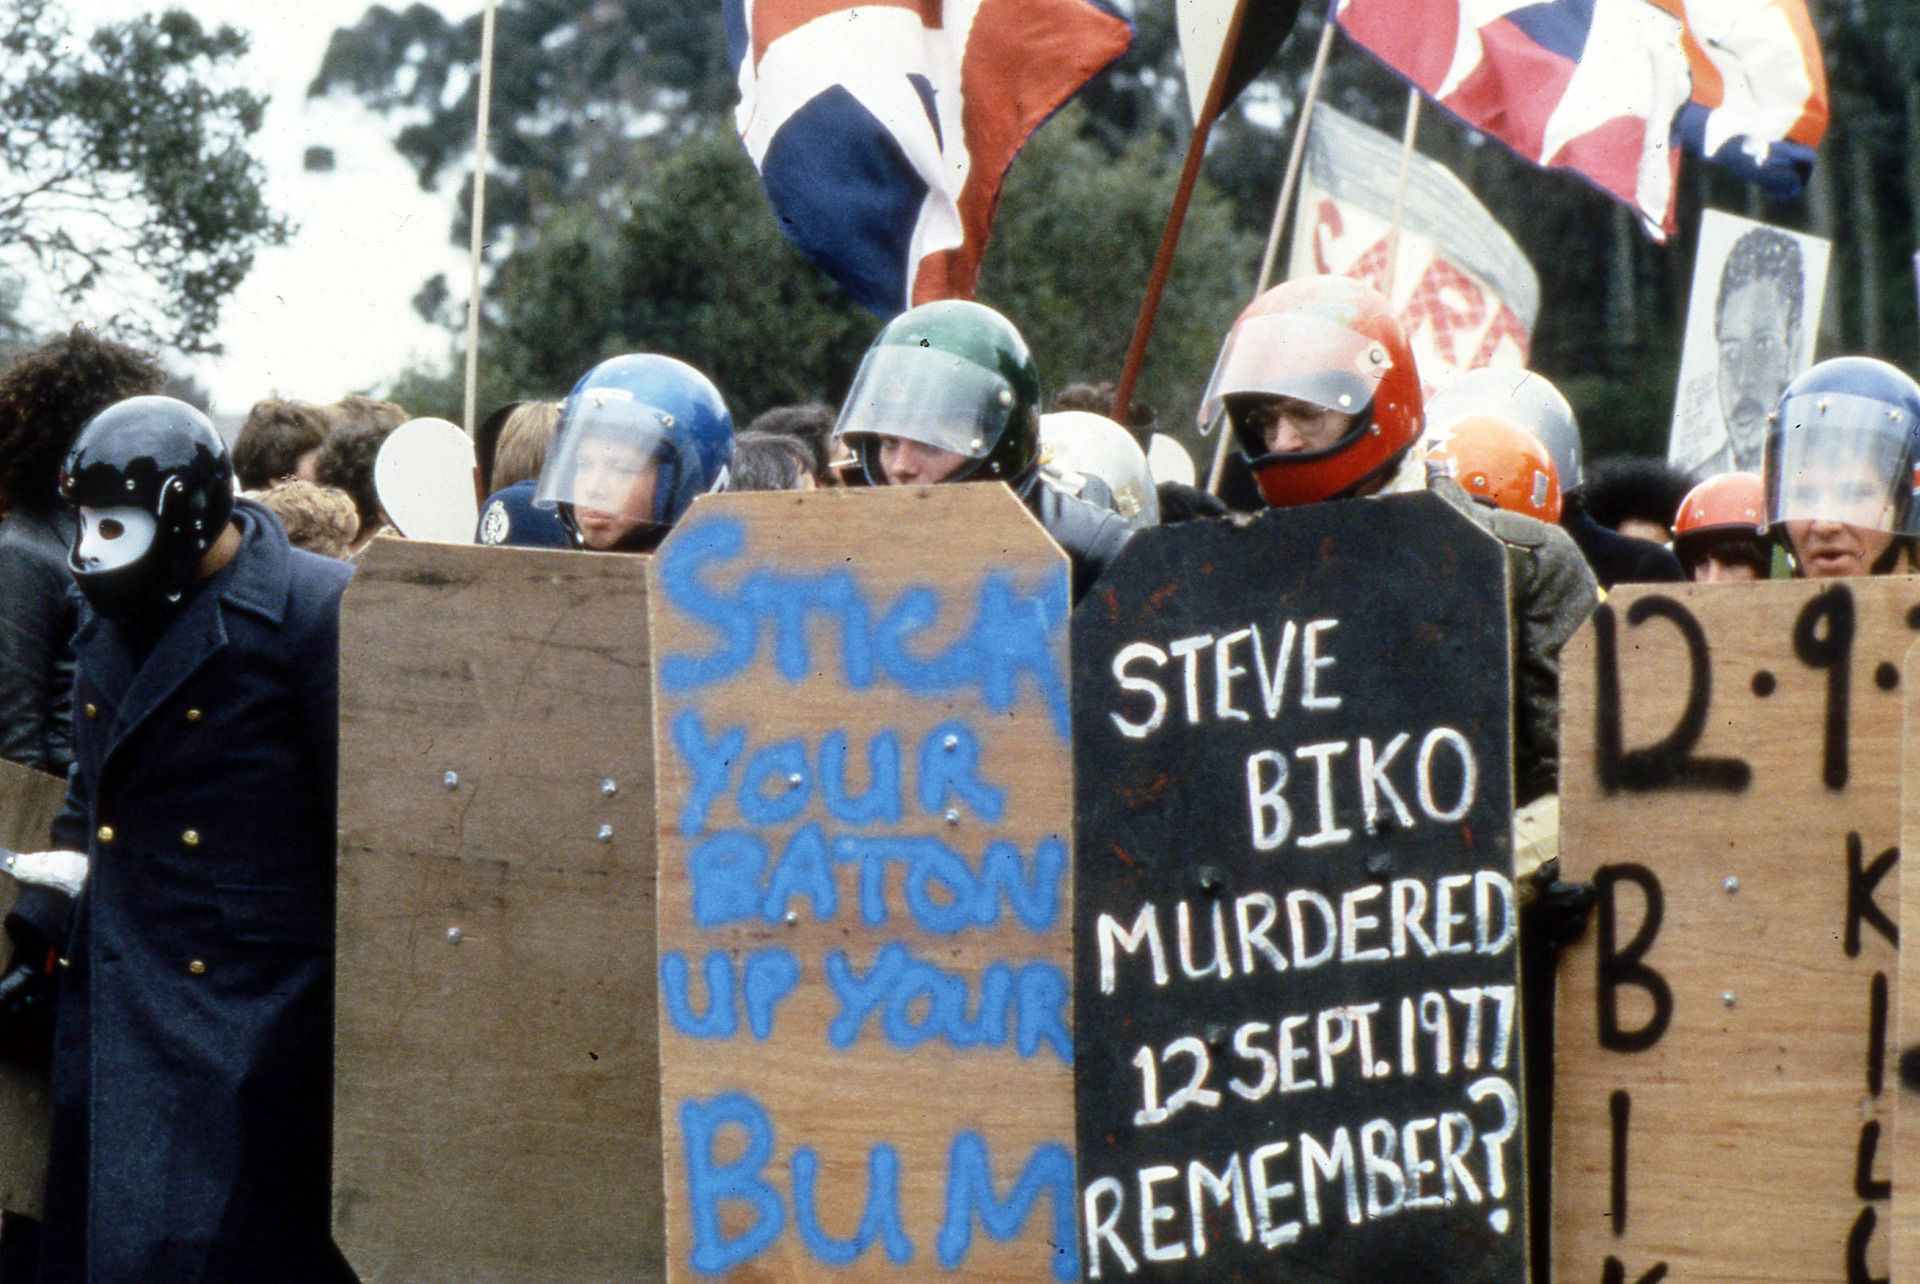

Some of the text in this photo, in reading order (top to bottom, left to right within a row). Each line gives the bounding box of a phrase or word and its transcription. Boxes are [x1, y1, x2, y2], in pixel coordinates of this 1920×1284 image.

[1110, 619, 1342, 739] STEVE
[1594, 583, 1920, 795] 12.9.
[670, 706, 1005, 838] YOUR
[1247, 727, 1478, 850] BIKO
[687, 820, 1068, 936] BATON
[1097, 870, 1517, 995] MURDERED
[661, 940, 1075, 1064] UP YOUR
[1133, 986, 1515, 1126] 12 SEPT. 1977
[678, 1089, 1080, 1284] BUM
[1084, 1076, 1518, 1278] REMEMBER?
